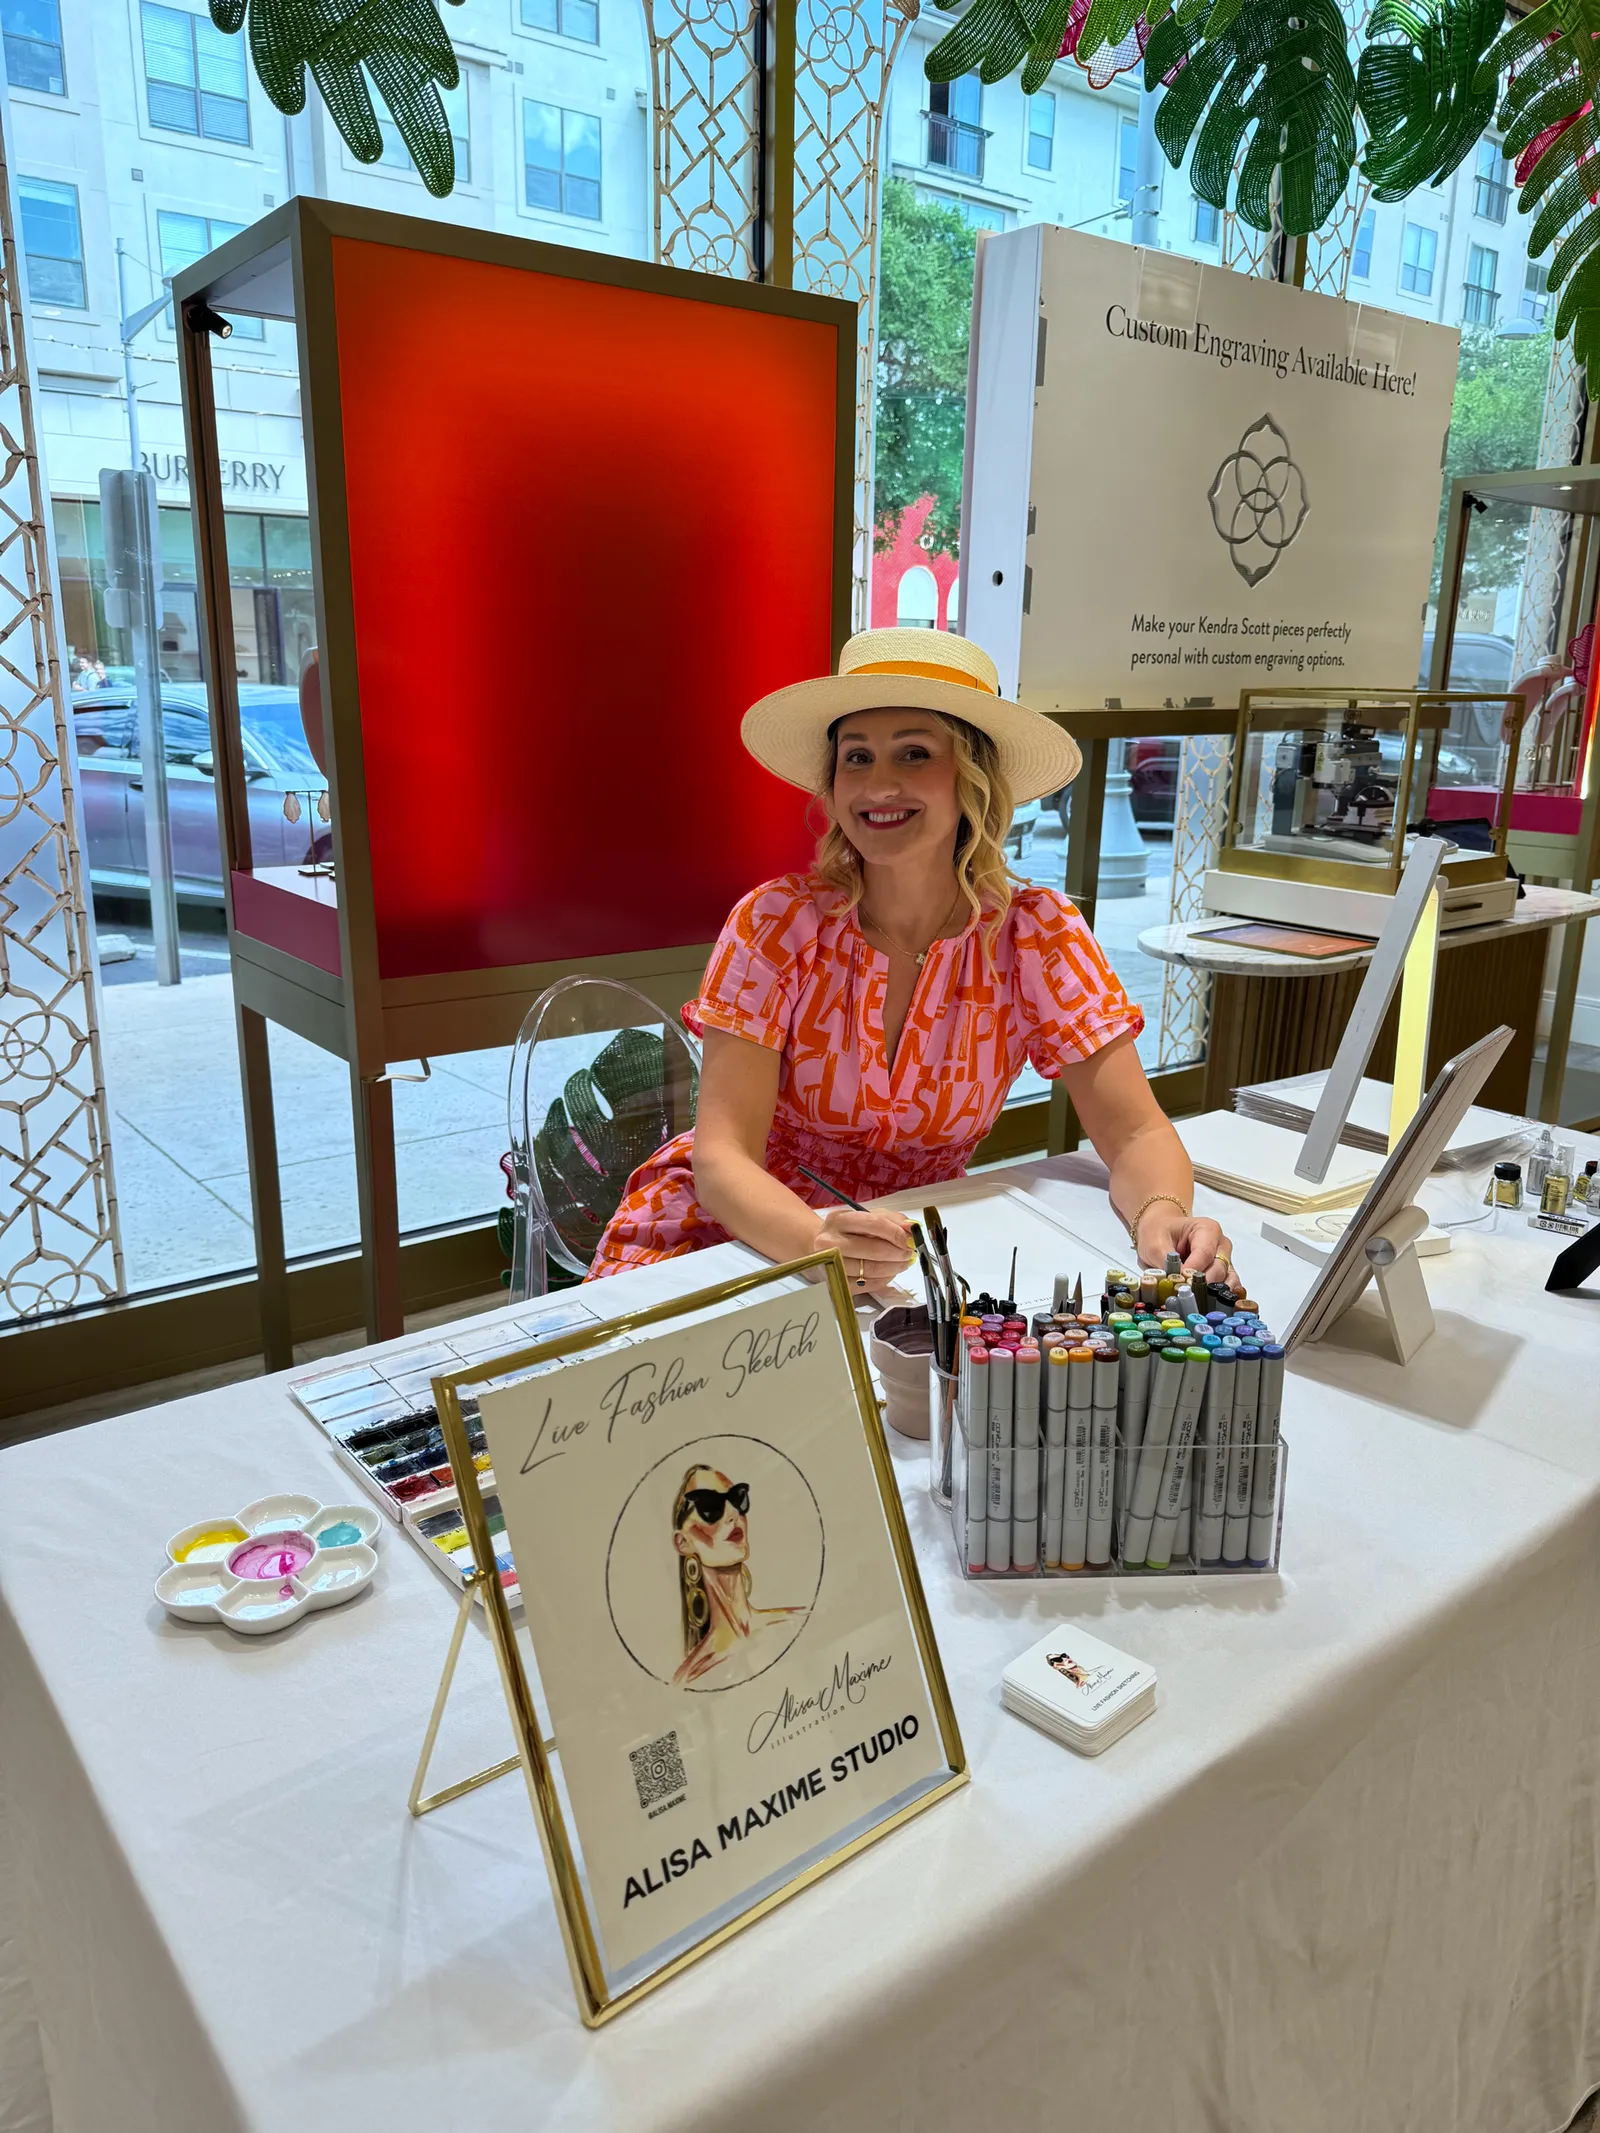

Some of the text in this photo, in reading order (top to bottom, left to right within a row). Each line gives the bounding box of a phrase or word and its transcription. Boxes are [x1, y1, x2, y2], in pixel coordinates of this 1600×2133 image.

[1105, 304, 1417, 397] Custom Engraving Available Here!
[140, 451, 286, 491] BURERRY
[1130, 646, 1345, 672] personal with custom engraving options.
[1131, 614, 1351, 644] Make your Kendra Scott pieces perfectly
[519, 1311, 820, 1475] Live Fashion Sketch
[747, 1651, 892, 1754] Alisa Maxime
[623, 1714, 920, 1910] ALISA MAXIME STUDIO
